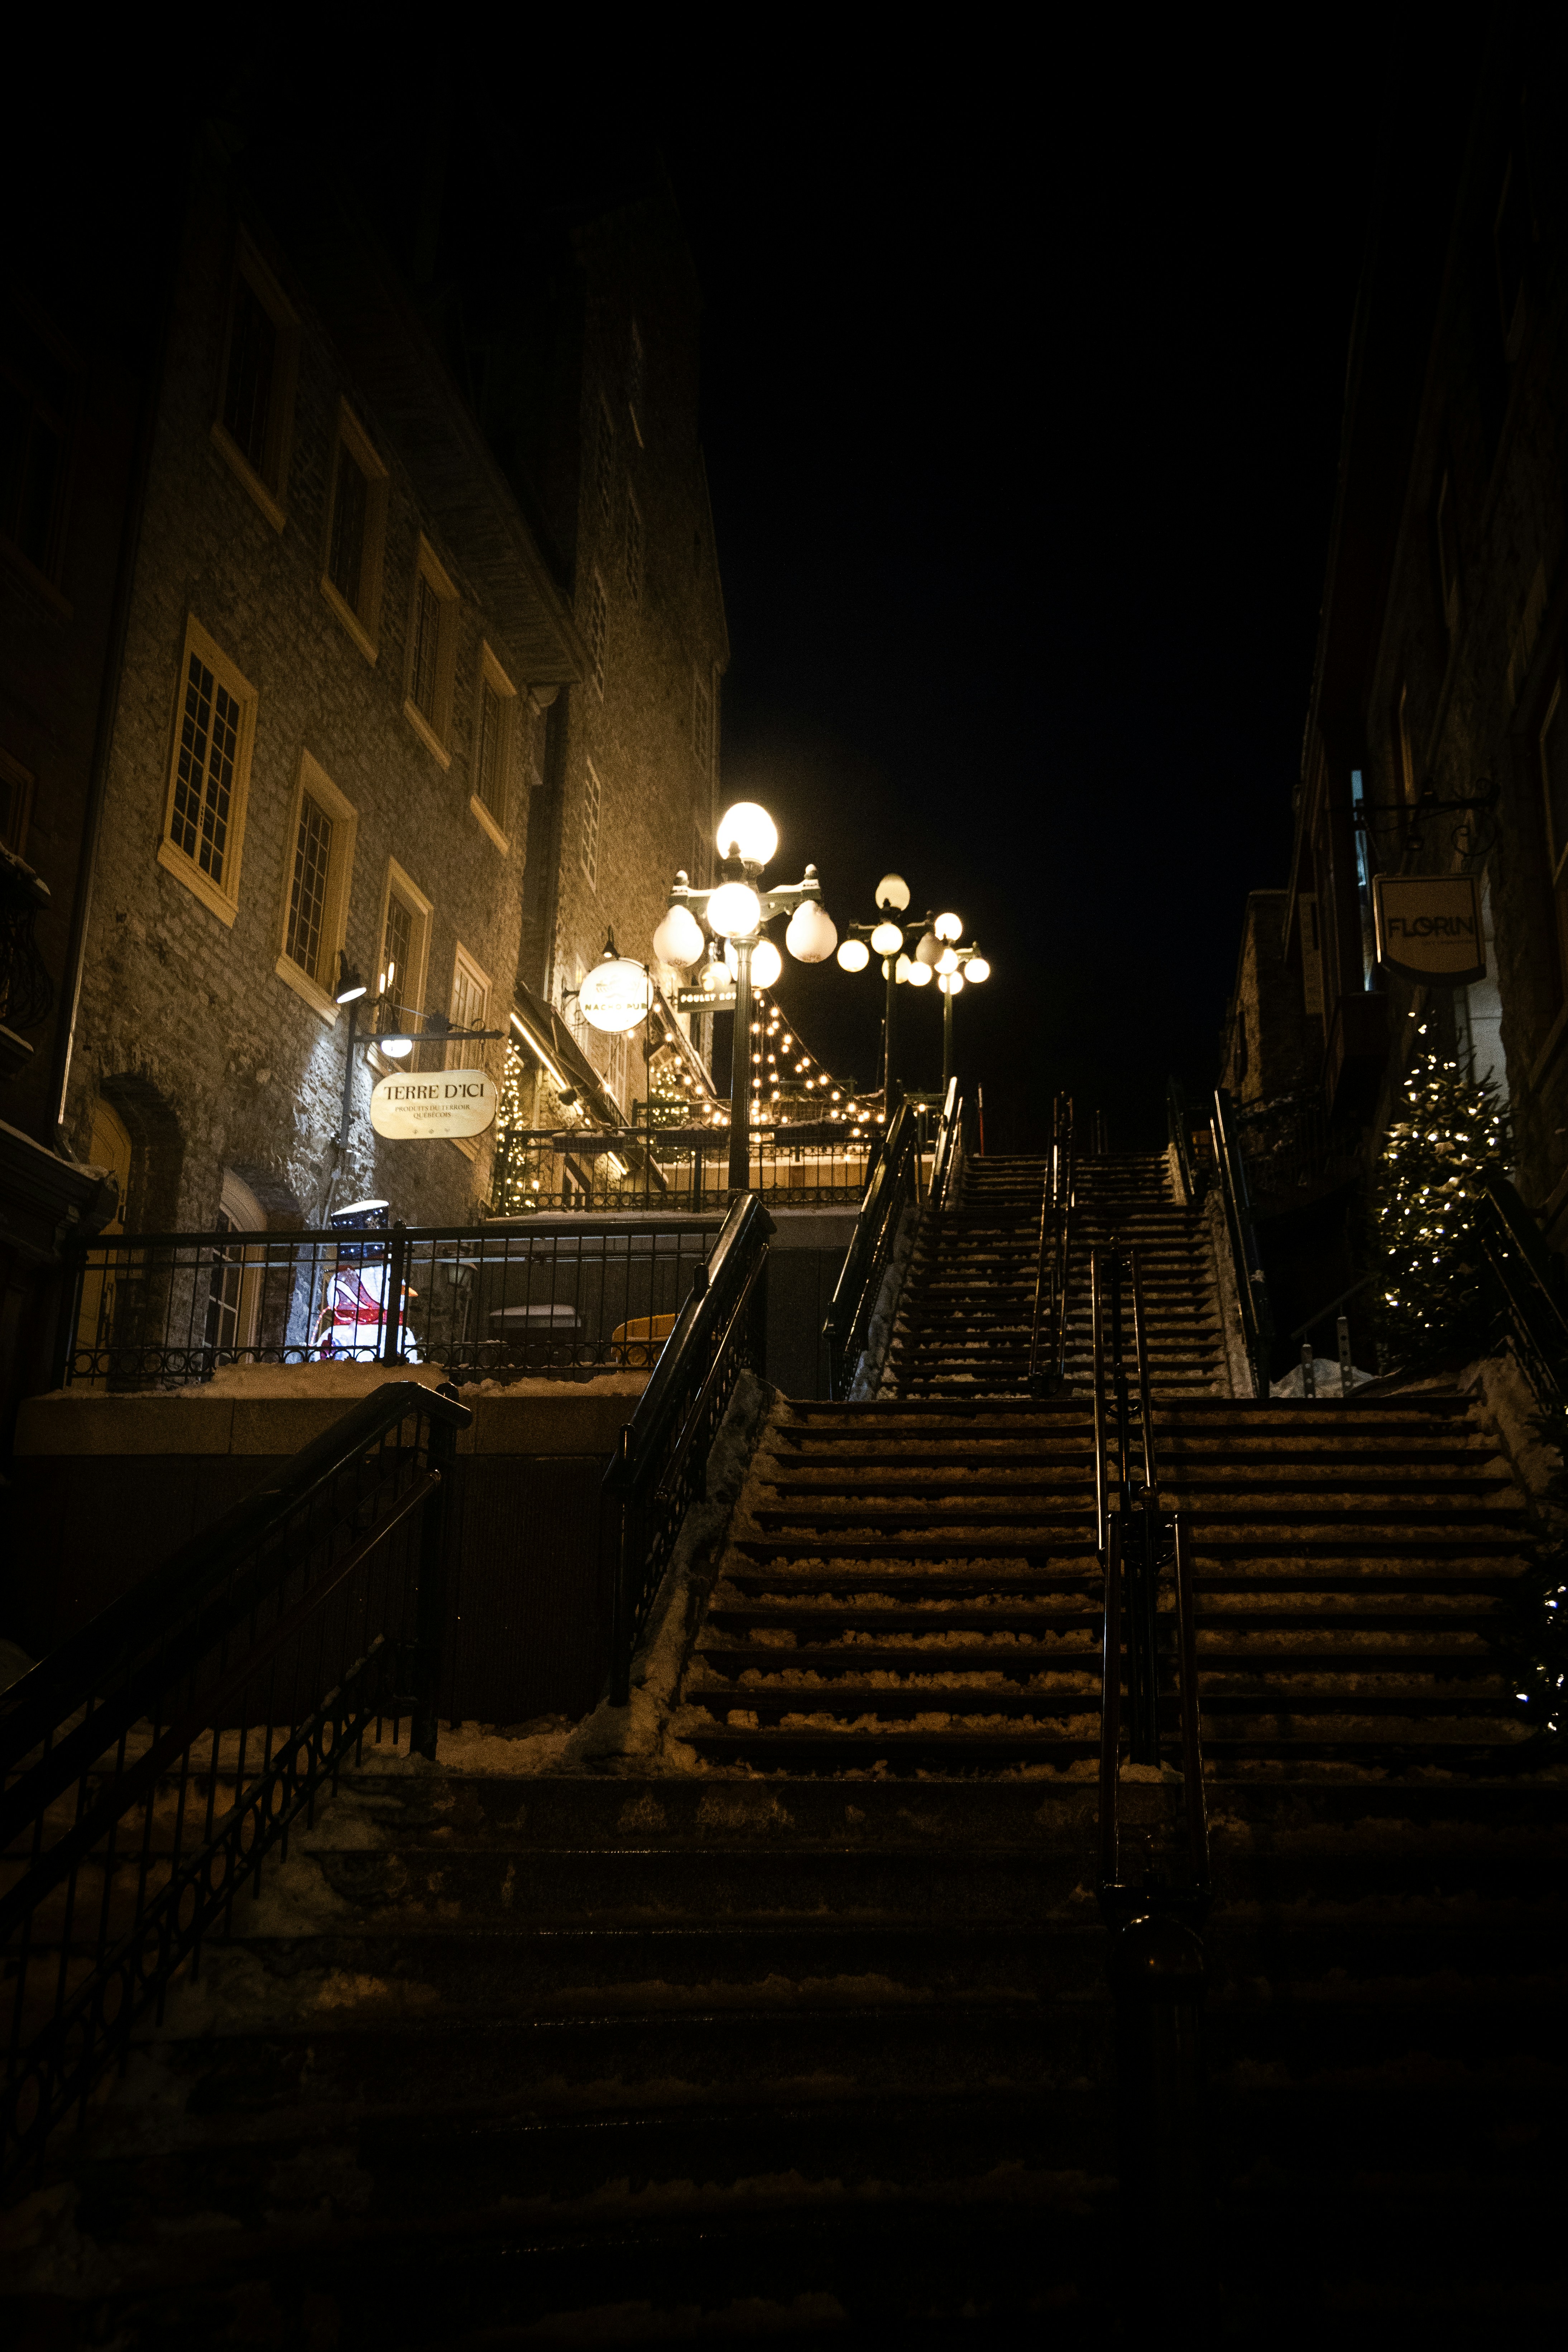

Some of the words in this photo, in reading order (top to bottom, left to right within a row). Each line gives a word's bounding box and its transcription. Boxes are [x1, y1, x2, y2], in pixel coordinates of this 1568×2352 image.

[1388, 916, 1473, 938] FLORIN
[681, 993, 716, 1003] POULET
[719, 992, 737, 1000] ROT
[384, 1085, 439, 1100] TERRE
[445, 1083, 484, 1098] D'ICI
